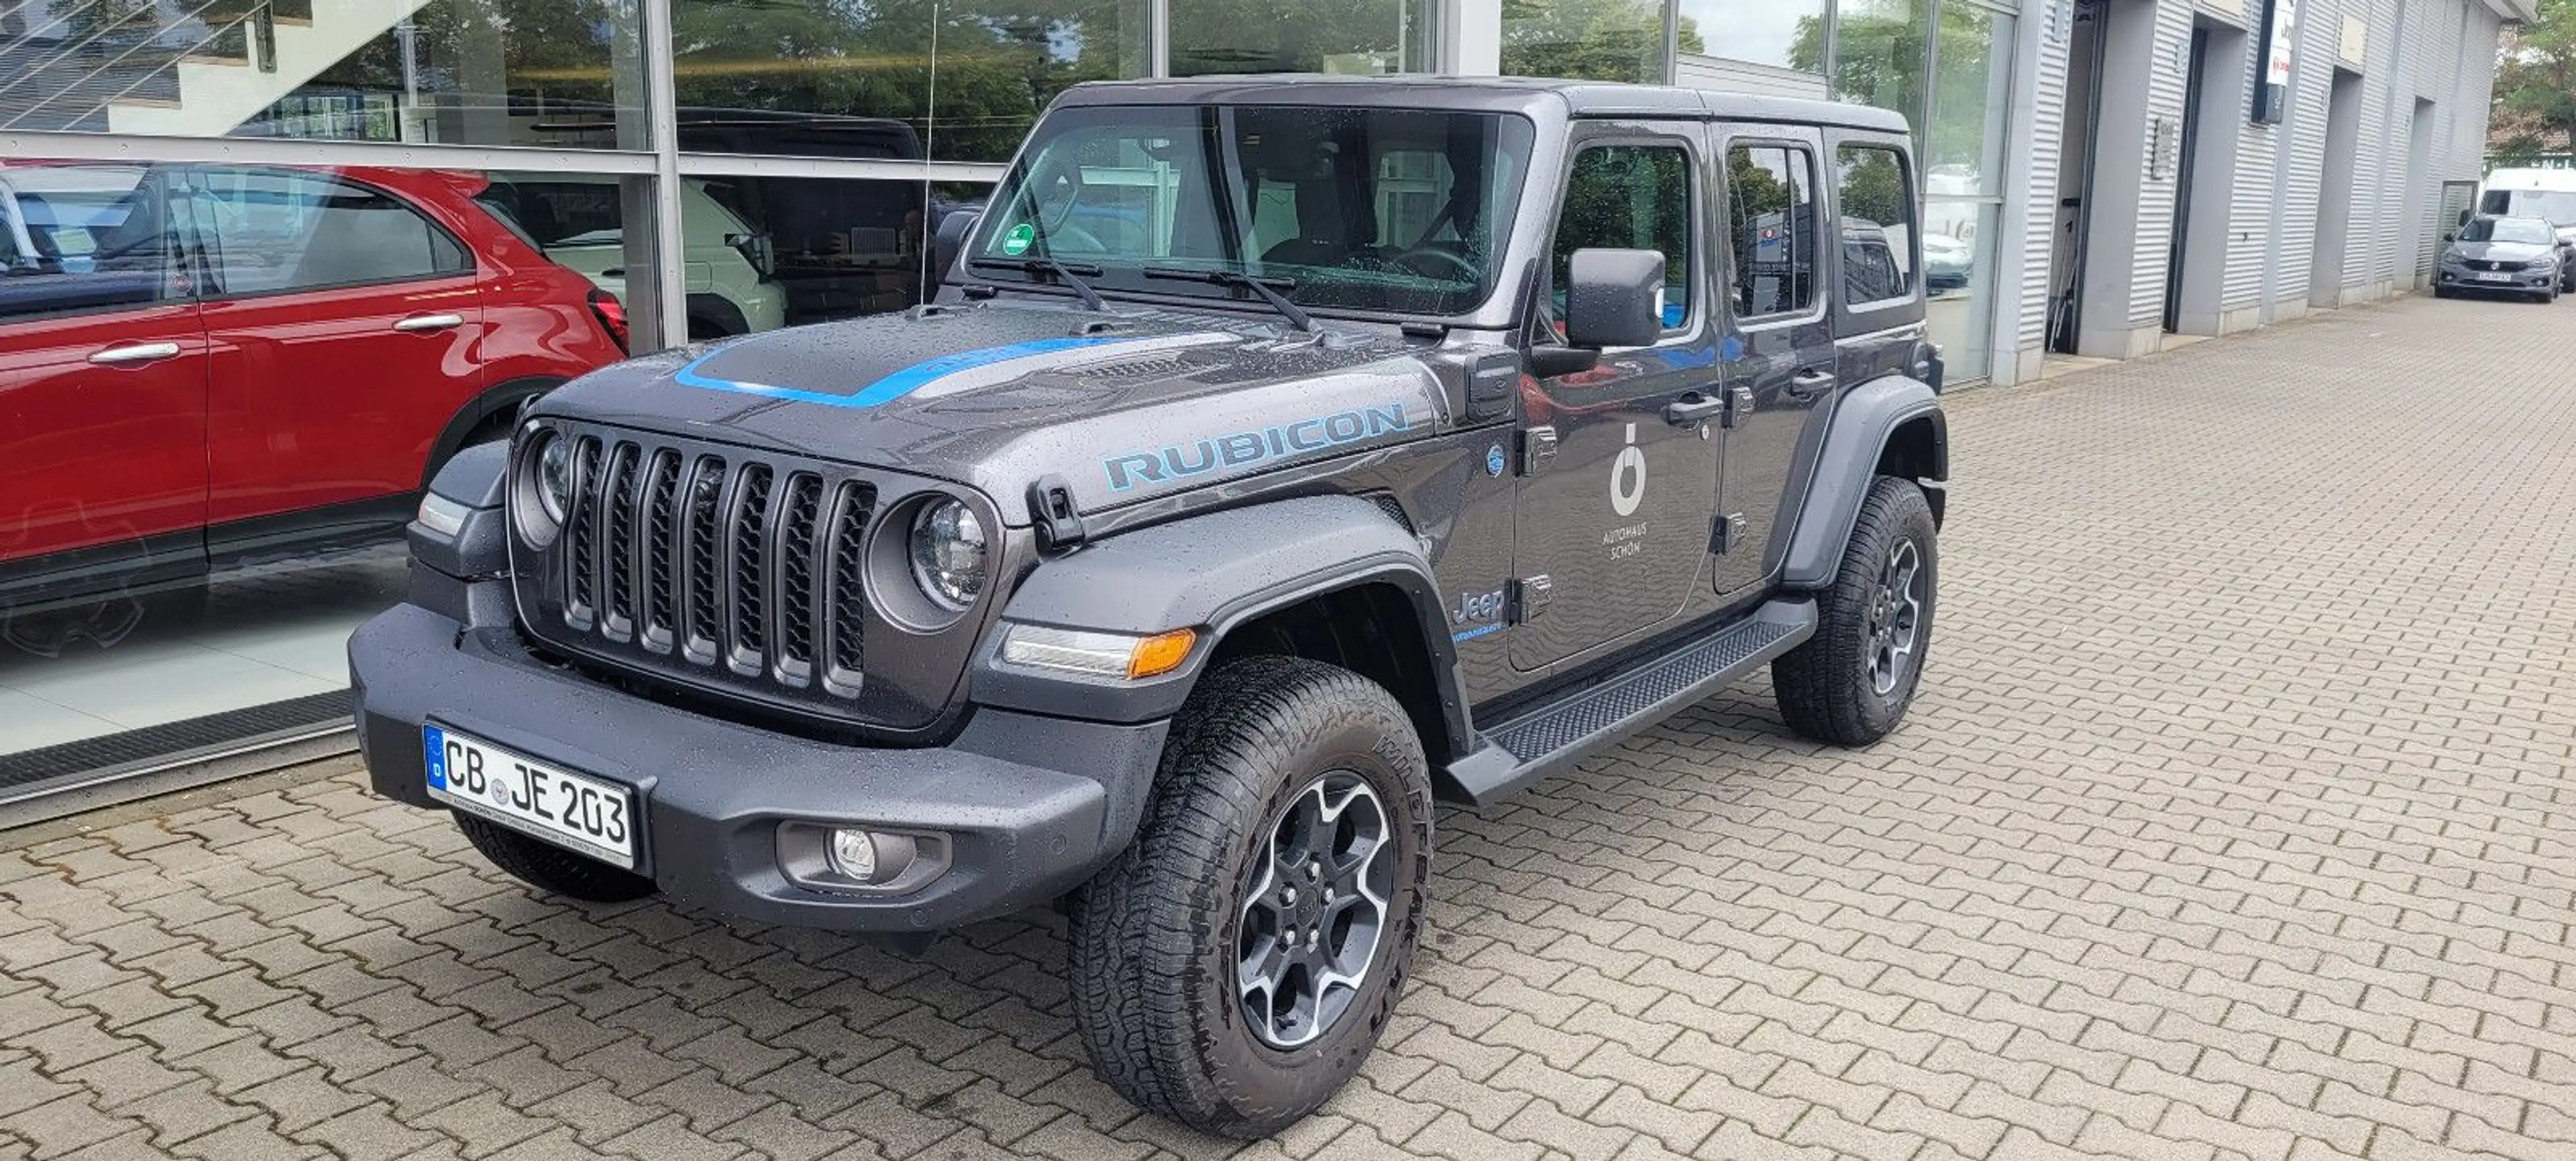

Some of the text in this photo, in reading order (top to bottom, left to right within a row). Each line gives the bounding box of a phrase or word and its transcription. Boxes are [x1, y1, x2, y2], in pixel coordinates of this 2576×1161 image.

[1101, 401, 1409, 491] RUBICON
[1602, 521, 1647, 546] AUTOHAUS
[1451, 591, 1505, 623] Jeep
[446, 741, 625, 844] CB JE 203
